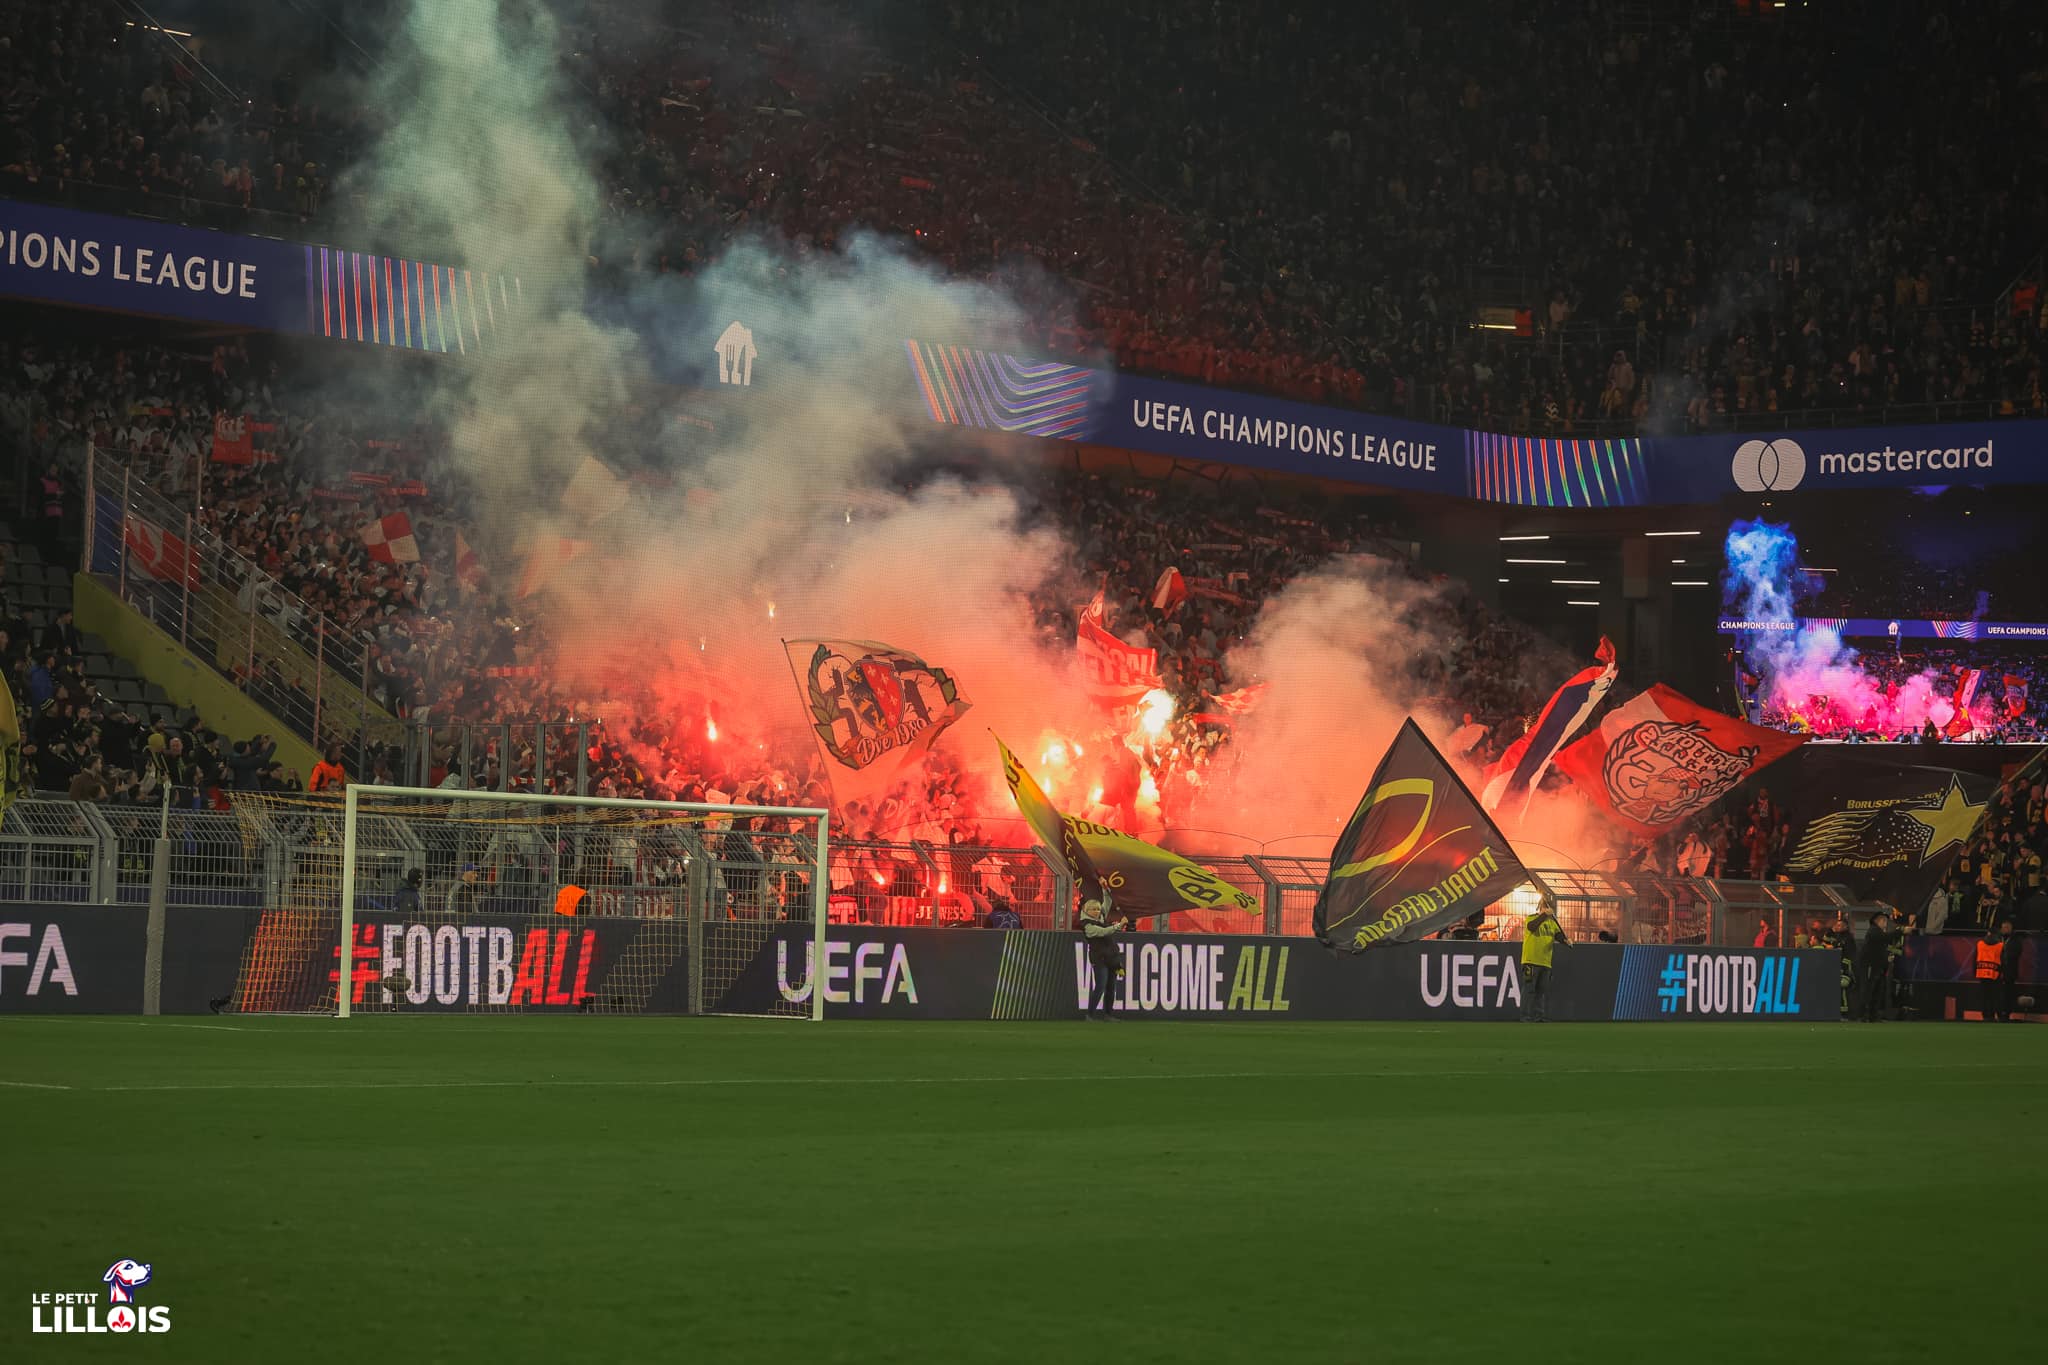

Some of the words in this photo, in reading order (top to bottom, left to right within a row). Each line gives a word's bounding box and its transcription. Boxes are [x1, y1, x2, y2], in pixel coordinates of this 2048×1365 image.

[0, 230, 100, 276] IONS
[114, 245, 257, 298] LEAGUE
[1133, 399, 1195, 435] UEFA
[1203, 410, 1344, 457] CHAMPIONS
[1351, 433, 1436, 471] LEAGUE
[1818, 439, 1993, 473] mastercard
[1720, 621, 1765, 630] CHAMPIONS
[1766, 622, 1795, 630] LEAGUE
[1987, 626, 2005, 634] UEFA
[2006, 627, 2046, 635] CHAMPIONS
[915, 905, 975, 921] JENESS
[1174, 867, 1222, 904] BV
[328, 923, 597, 1005] #FOOTBALL
[777, 940, 918, 1003] UEFA
[1227, 945, 1290, 1011] ALL
[1420, 954, 1521, 1008] UEFA
[1657, 953, 1800, 1013] #FOOTBALL
